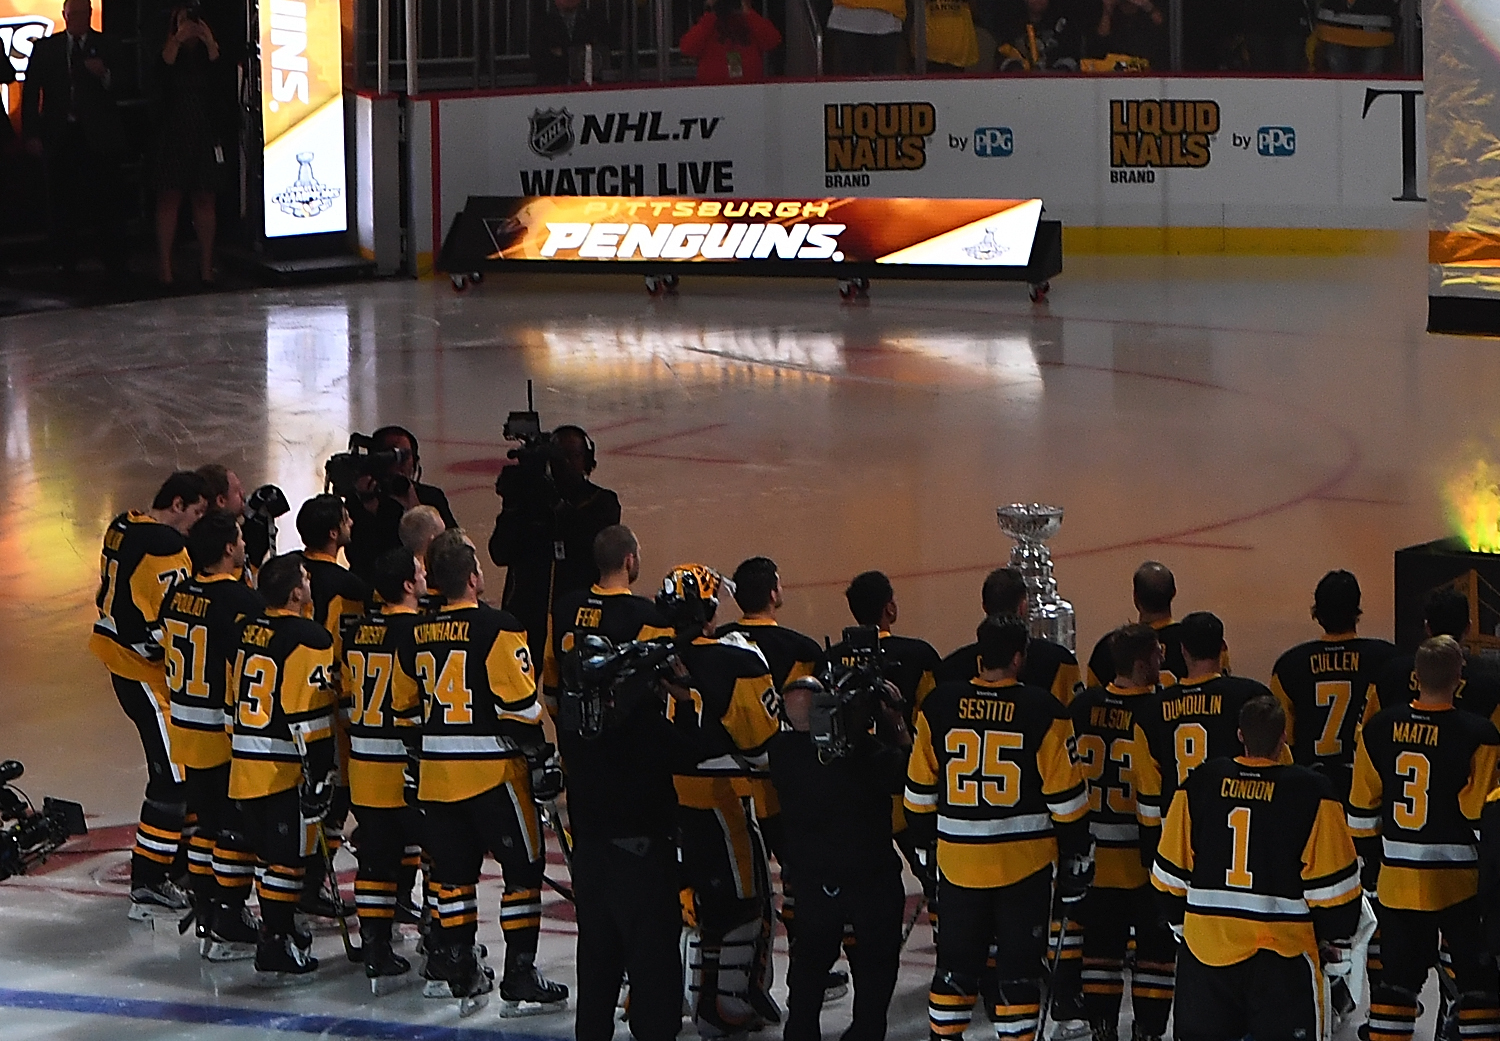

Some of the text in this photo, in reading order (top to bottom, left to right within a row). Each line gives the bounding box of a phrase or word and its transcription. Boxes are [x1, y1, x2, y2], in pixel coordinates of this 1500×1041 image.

[580, 111, 720, 145] NHL.TV
[823, 102, 936, 138] LIQUID
[1110, 100, 1220, 135] LIQUID
[823, 135, 927, 172] NAILS
[948, 128, 1013, 156] by PPG
[1110, 132, 1213, 168] NAILS
[1232, 127, 1296, 155] by PPG
[520, 161, 734, 197] WATCH LIVE
[824, 174, 871, 188] BRAND
[1110, 170, 1156, 184] BRAND
[583, 200, 831, 218] PITTSBURGH
[541, 221, 847, 262] PENGUINS
[161, 616, 212, 699] 51
[1309, 652, 1360, 675] CULLEN
[414, 648, 474, 725] 34
[958, 697, 1017, 724] SESTITO
[1090, 705, 1134, 731] WILSON
[1161, 693, 1223, 722] DUMOULIN
[1313, 679, 1352, 757] 7
[1392, 721, 1440, 748] MAATTA
[944, 727, 1025, 808] 25
[1077, 733, 1137, 814] 23
[1220, 777, 1276, 803] CONDON
[1392, 750, 1431, 832] 3
[1225, 806, 1254, 889] 1
